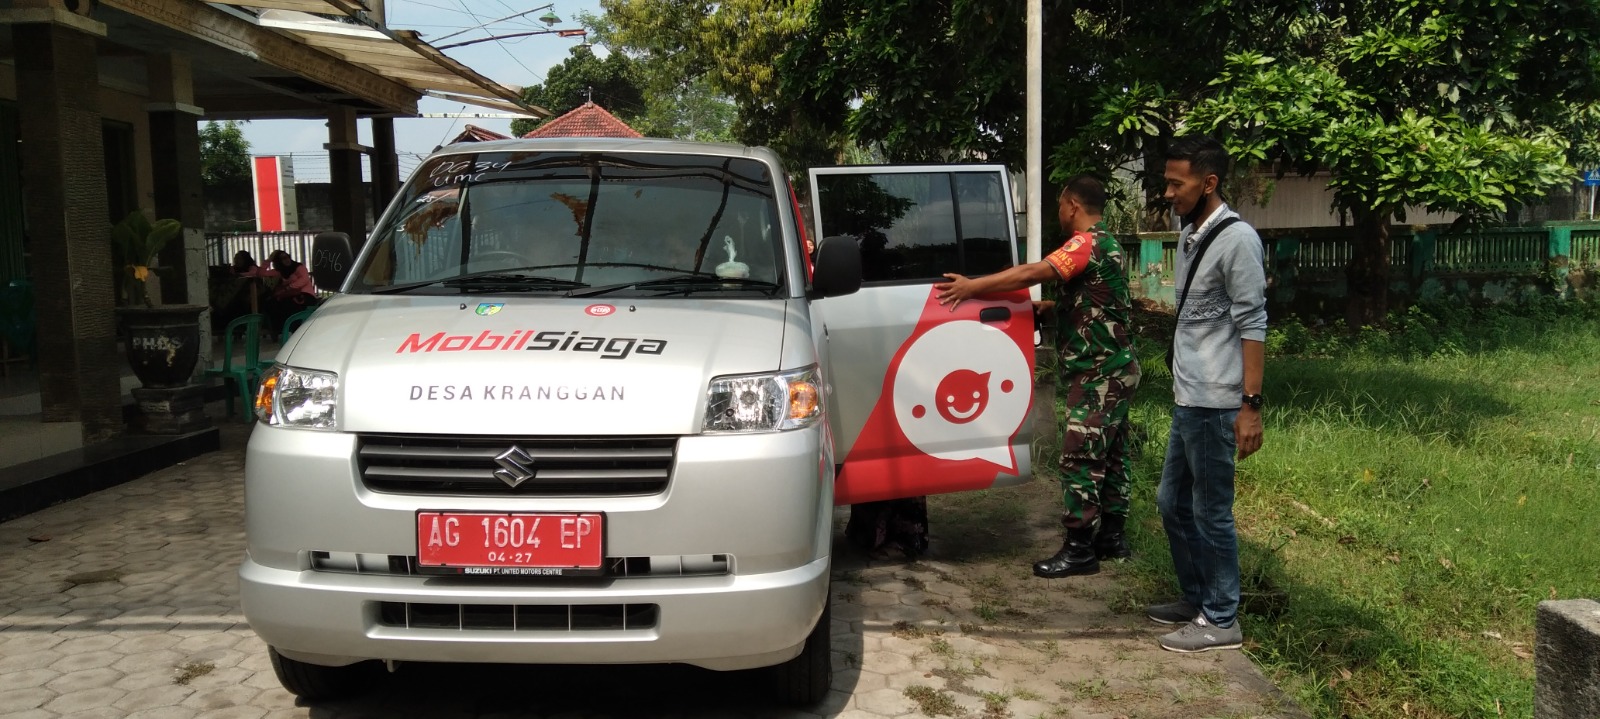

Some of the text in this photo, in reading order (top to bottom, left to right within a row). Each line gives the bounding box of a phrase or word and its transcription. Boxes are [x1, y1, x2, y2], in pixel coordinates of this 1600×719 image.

[409, 385, 625, 401] DESA KRANGGAN
[428, 516, 591, 549] AG 1604 EP
[501, 568, 520, 576] UNITED
[520, 568, 541, 576] MOTORS
